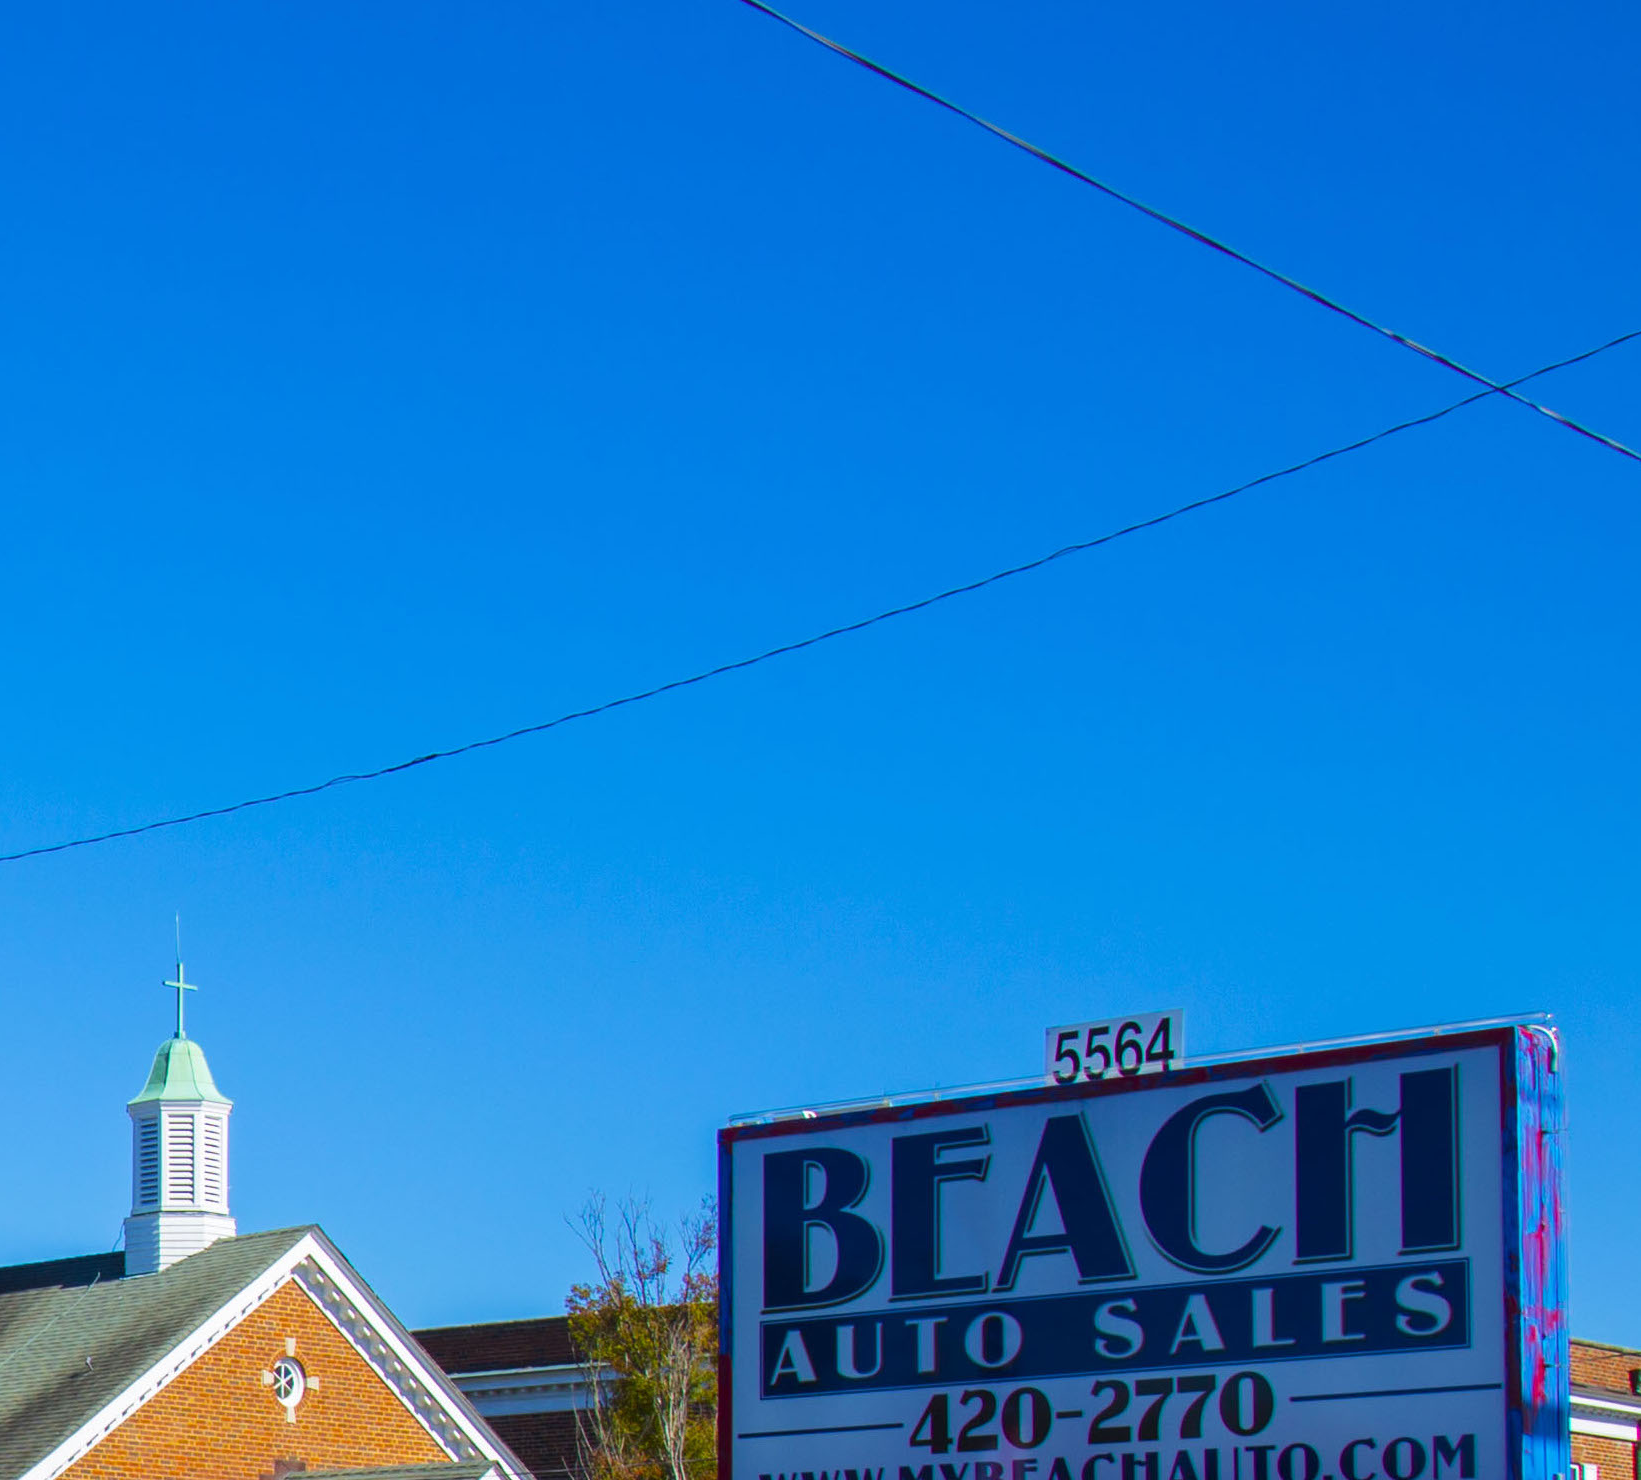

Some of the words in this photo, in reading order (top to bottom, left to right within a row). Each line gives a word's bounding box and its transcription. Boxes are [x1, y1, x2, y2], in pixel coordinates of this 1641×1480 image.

[1053, 1017, 1175, 1084] 5564
[761, 1064, 1460, 1314] BEACH
[770, 1310, 1024, 1387] AUTO
[1094, 1272, 1453, 1360] SALES
[909, 1372, 1275, 1455] 420-2770
